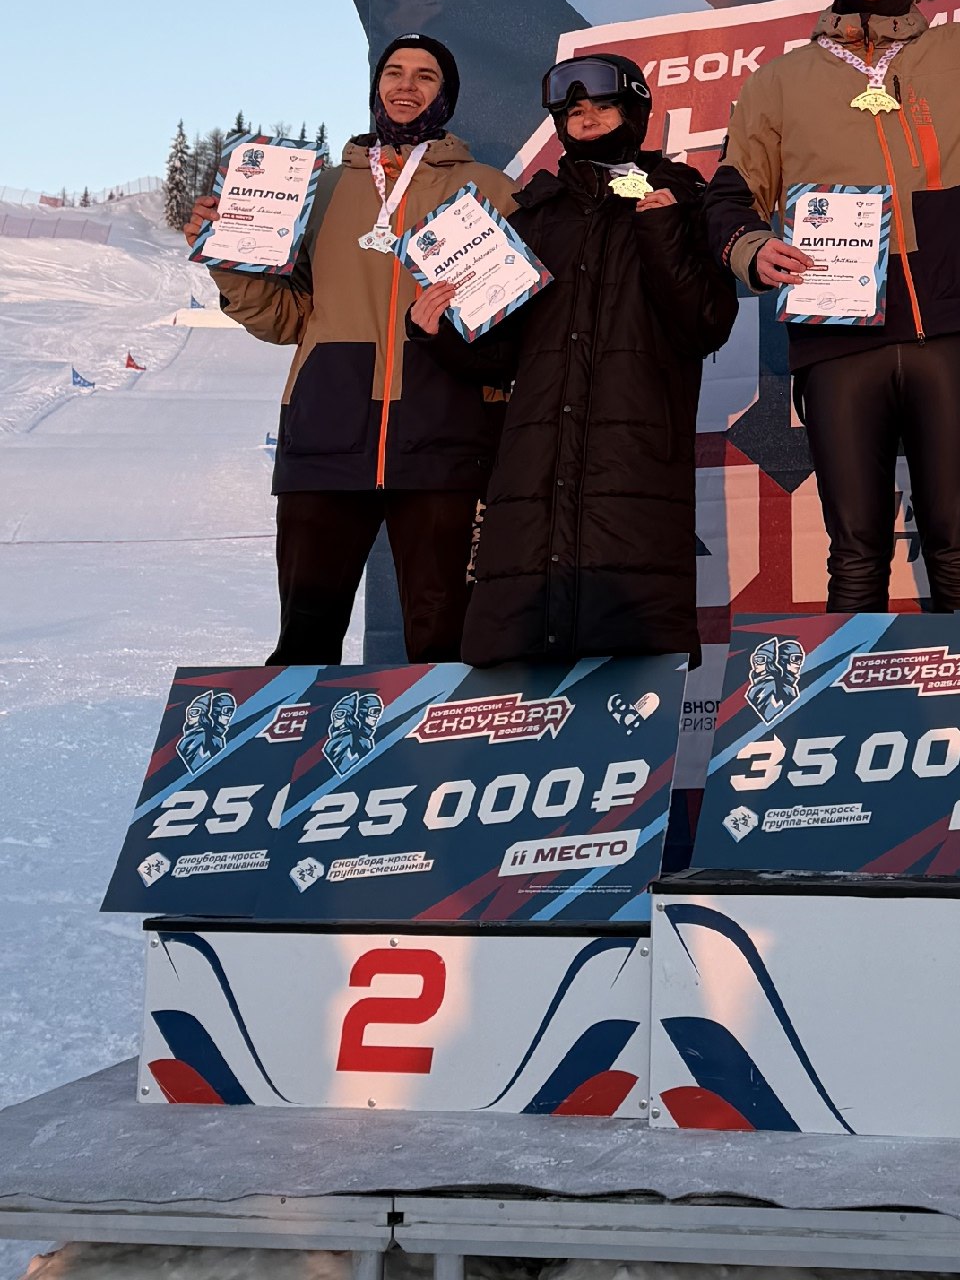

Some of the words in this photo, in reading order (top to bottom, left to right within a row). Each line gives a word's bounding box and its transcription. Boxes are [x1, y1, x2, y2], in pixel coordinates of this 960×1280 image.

[642, 46, 766, 87] УБОК
[228, 186, 299, 203] ДИПЛОМ
[433, 227, 496, 277] ДИПЛОМ
[799, 237, 874, 248] ДИПЛОМ
[856, 658, 888, 667] КУБОК
[890, 655, 930, 665] РОССИИ
[424, 704, 563, 734] СНОУБОРД
[431, 707, 462, 718] КУБОК
[464, 703, 503, 713] РОССИИ
[498, 725, 540, 736] 2025/26
[729, 733, 846, 792] 35
[298, 785, 418, 843] 25
[764, 814, 870, 829] группа-смешанная
[532, 840, 628, 863] МЕСТО
[328, 862, 431, 879] группа-смешанная
[336, 948, 446, 1074] 2
